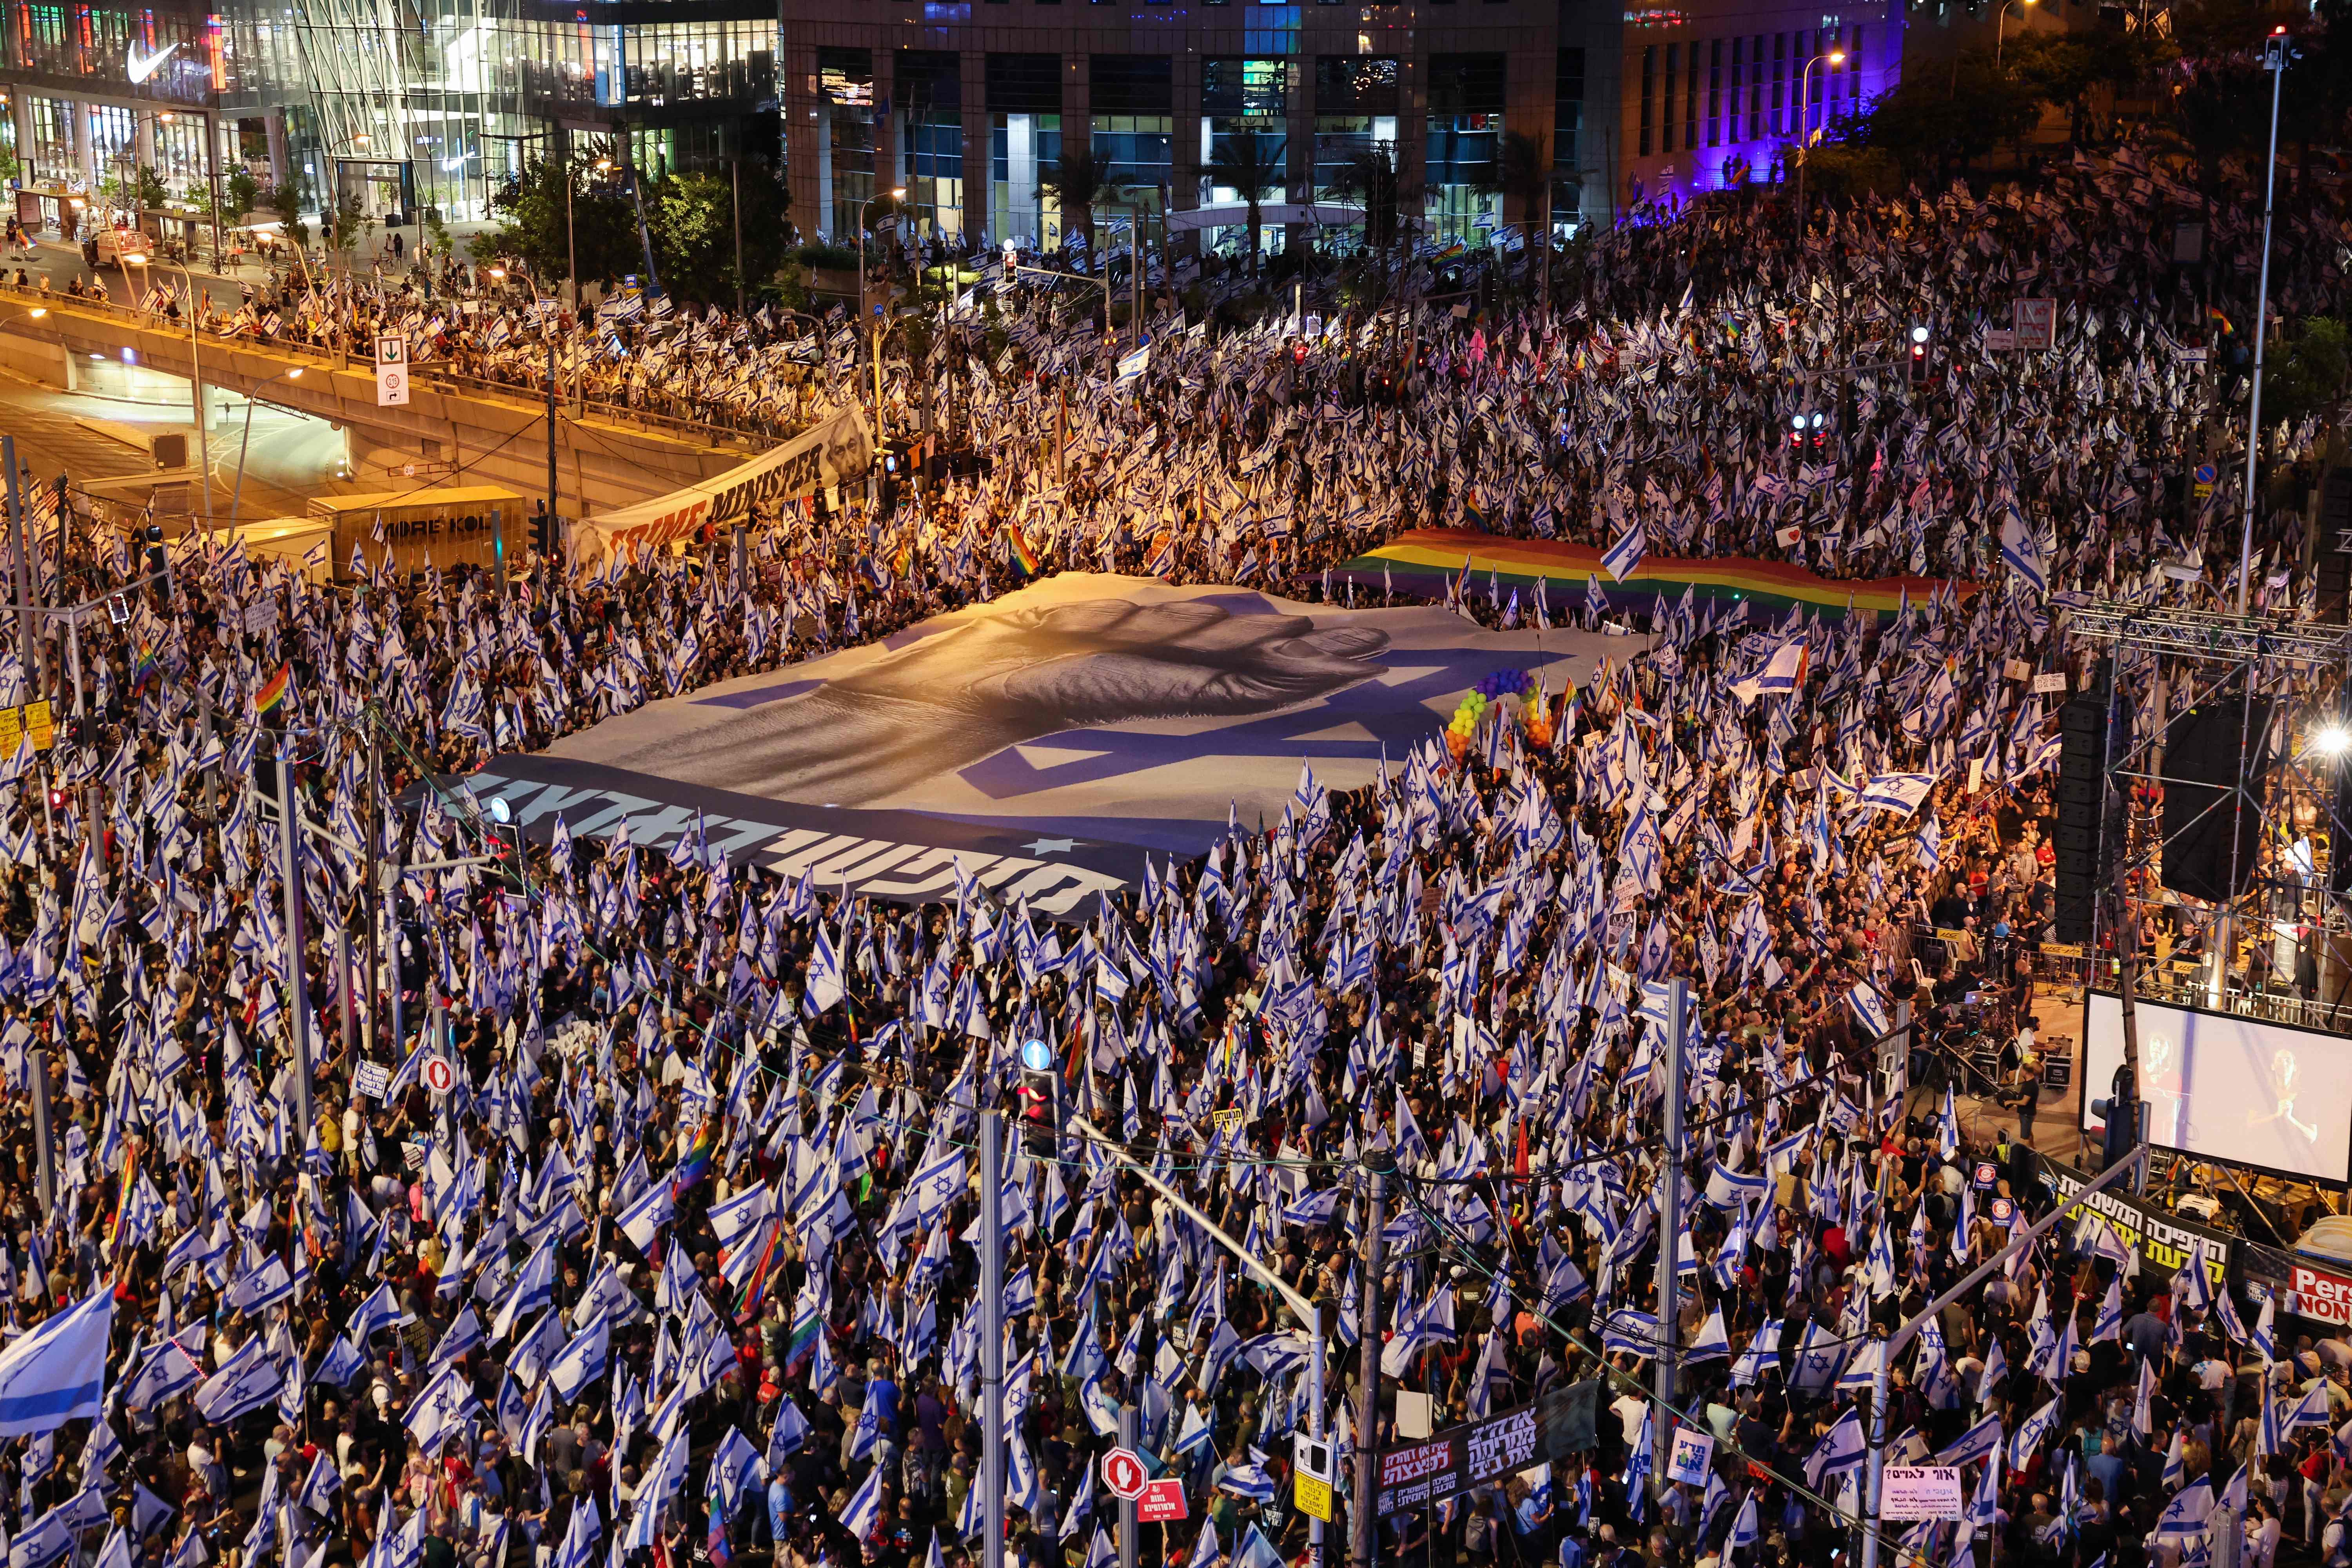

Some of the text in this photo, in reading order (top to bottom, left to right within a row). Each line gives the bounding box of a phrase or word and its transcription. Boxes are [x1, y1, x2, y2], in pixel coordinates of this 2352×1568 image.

[610, 443, 823, 564] CRIME MINISTER
[450, 516, 491, 533] KOL
[403, 774, 1128, 915] חופשי בארצנו
[2296, 1293, 2350, 1322] NON
[1679, 1440, 1706, 1454] תדע
[1468, 1443, 1535, 1480] את ביבי
[1886, 1468, 1955, 1480] אור לגויים?
[1297, 1474, 1328, 1492] נתיב תחבורה
[1303, 1483, 1321, 1495] ציבורית
[1301, 1495, 1323, 1510] באמצעות
[1304, 1491, 1319, 1501] אכיפה
[1302, 1503, 1321, 1515] מצלמות
